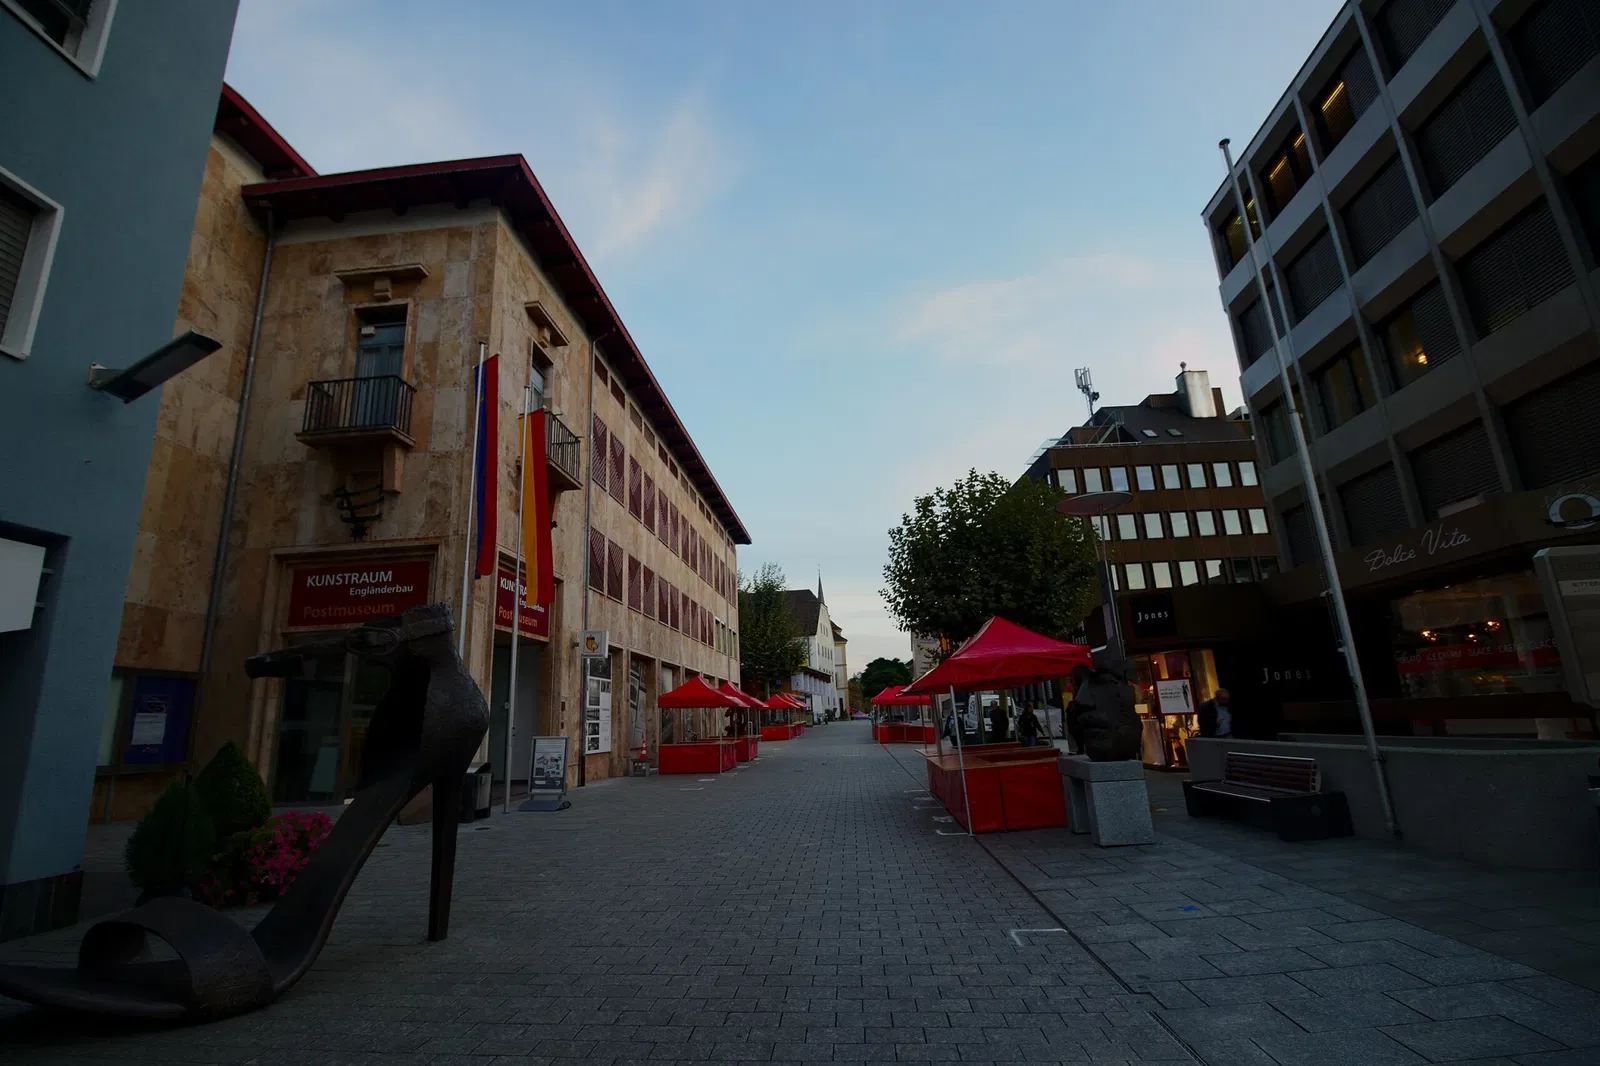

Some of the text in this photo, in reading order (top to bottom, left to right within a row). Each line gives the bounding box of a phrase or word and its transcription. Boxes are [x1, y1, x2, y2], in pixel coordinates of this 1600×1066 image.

[1363, 523, 1472, 572] Dolce Vita
[306, 570, 393, 588] KUNSTRAUM
[349, 585, 414, 597] Engländerbau
[303, 603, 396, 619] Postmuseum
[498, 605, 538, 627] Postuseum
[1137, 610, 1169, 623] Jones
[1261, 667, 1313, 684] Jones
